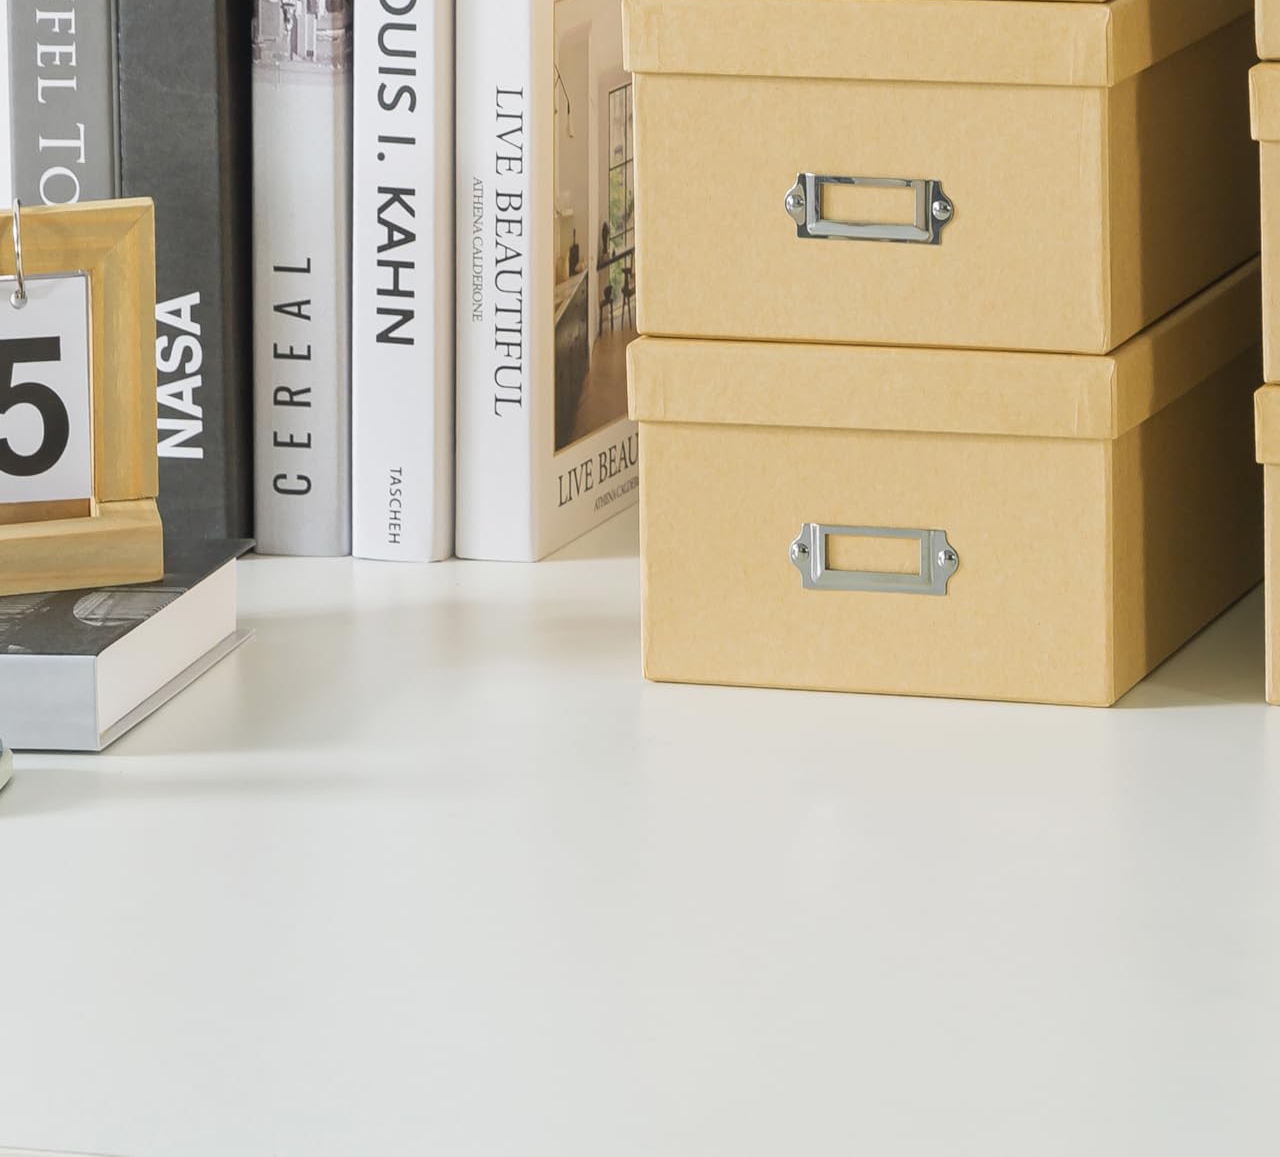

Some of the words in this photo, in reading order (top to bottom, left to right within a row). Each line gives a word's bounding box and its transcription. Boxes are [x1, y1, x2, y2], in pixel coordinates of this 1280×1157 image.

[39, 122, 85, 205] TO
[377, 135, 415, 161] I.
[495, 86, 524, 176] LIVE
[472, 176, 484, 233] ATHENA
[376, 187, 416, 345] KAHN
[471, 235, 484, 323] CALDERONE
[494, 189, 523, 417] BEAUTIFUL
[0, 336, 69, 476] 5
[156, 291, 204, 459] NASA
[273, 258, 311, 495] CEREAL
[558, 459, 593, 507] LIVE
[598, 432, 639, 484] BEAU
